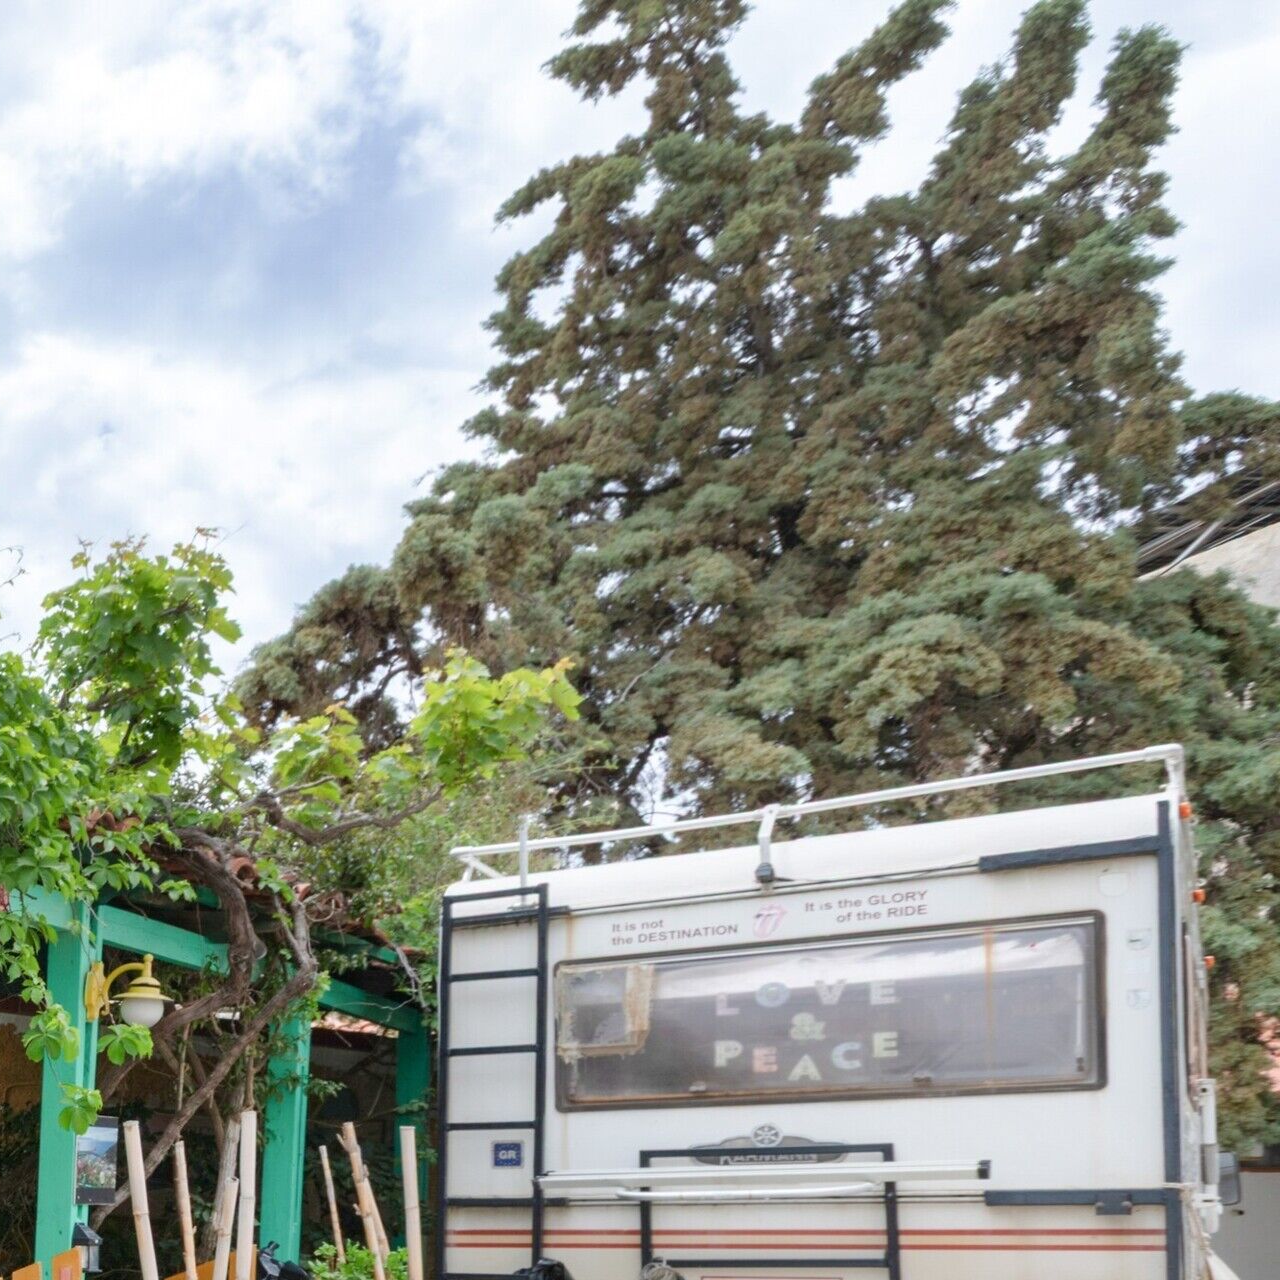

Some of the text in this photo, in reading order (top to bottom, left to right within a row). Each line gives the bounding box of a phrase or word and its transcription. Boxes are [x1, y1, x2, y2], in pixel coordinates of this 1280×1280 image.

[804, 889, 928, 912] It is the GLORY
[836, 904, 928, 923] of the RIDE
[611, 919, 664, 933] It is not
[611, 924, 738, 946] the DESTINATION
[715, 979, 901, 1016] LOVE
[791, 1011, 826, 1040] &
[713, 1031, 899, 1081] PEACE
[498, 1150, 517, 1160] GR
